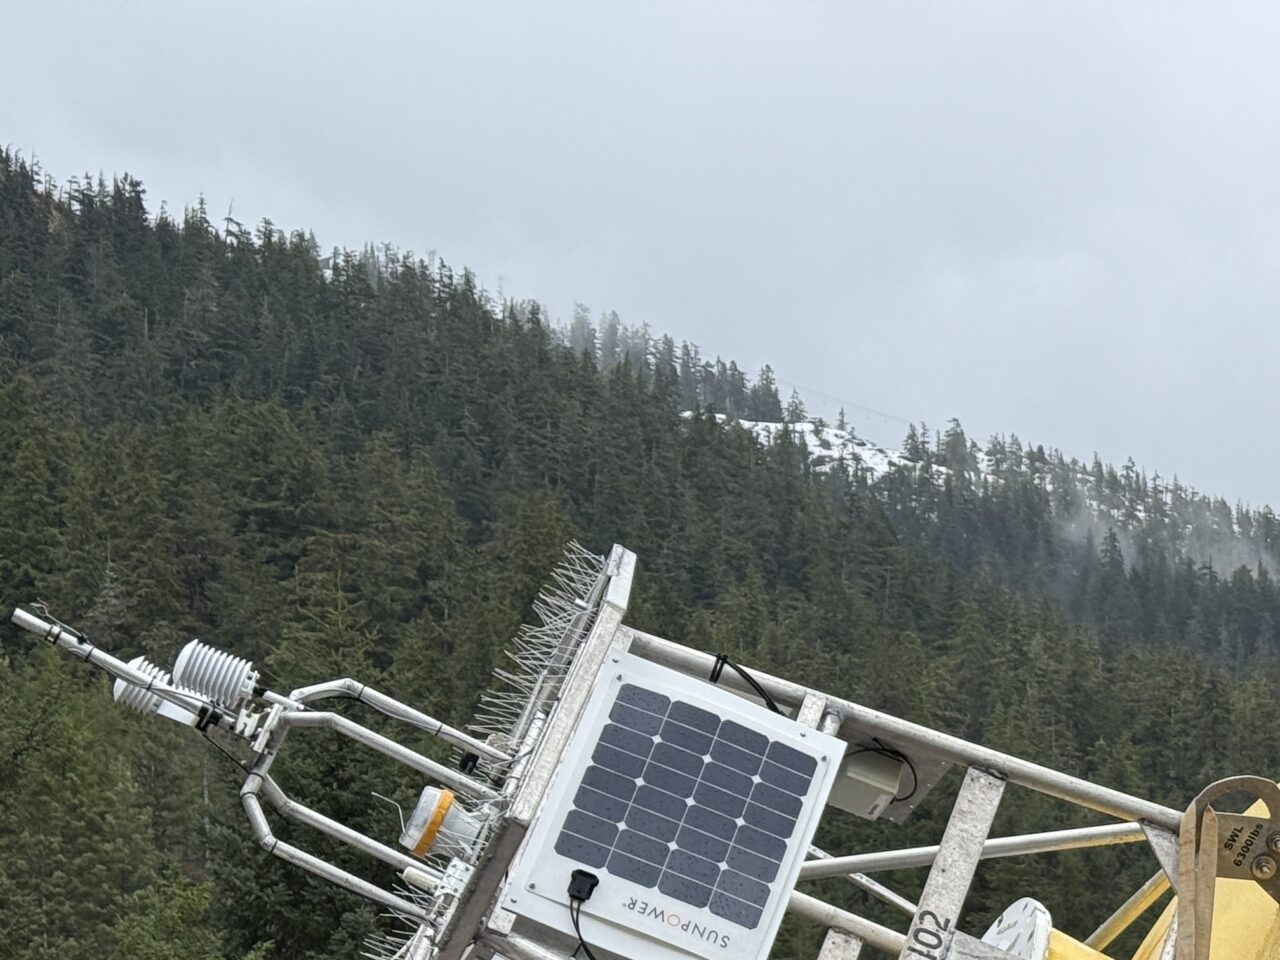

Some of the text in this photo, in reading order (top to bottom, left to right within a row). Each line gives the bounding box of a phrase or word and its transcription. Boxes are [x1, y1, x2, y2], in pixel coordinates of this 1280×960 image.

[1224, 826, 1244, 850] SWL
[1233, 823, 1264, 867] 6300lbs
[627, 897, 731, 948] SUNPOWER
